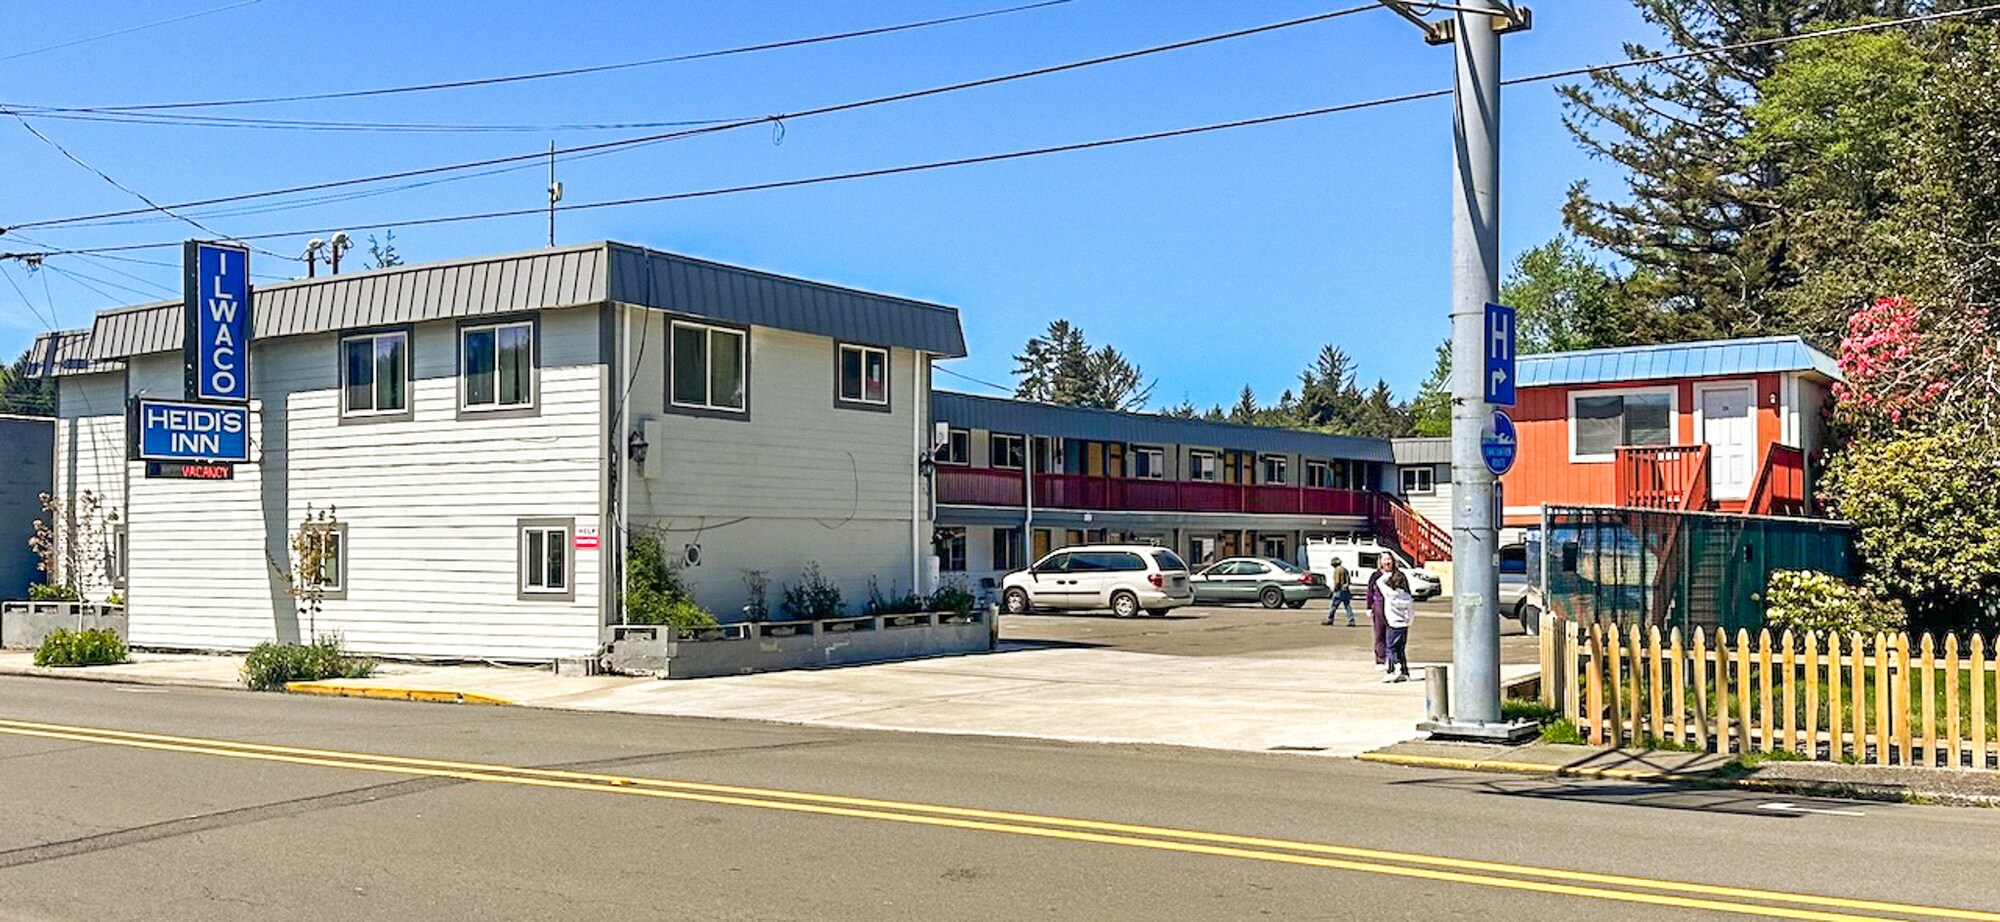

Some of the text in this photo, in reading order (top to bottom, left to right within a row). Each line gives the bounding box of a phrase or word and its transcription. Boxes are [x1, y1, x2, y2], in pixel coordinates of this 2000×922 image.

[208, 252, 238, 394] ILWACO
[1491, 311, 1508, 360] H
[148, 409, 242, 433] HEIDI'S
[171, 433, 219, 454] INN
[181, 465, 229, 479] VACANCY
